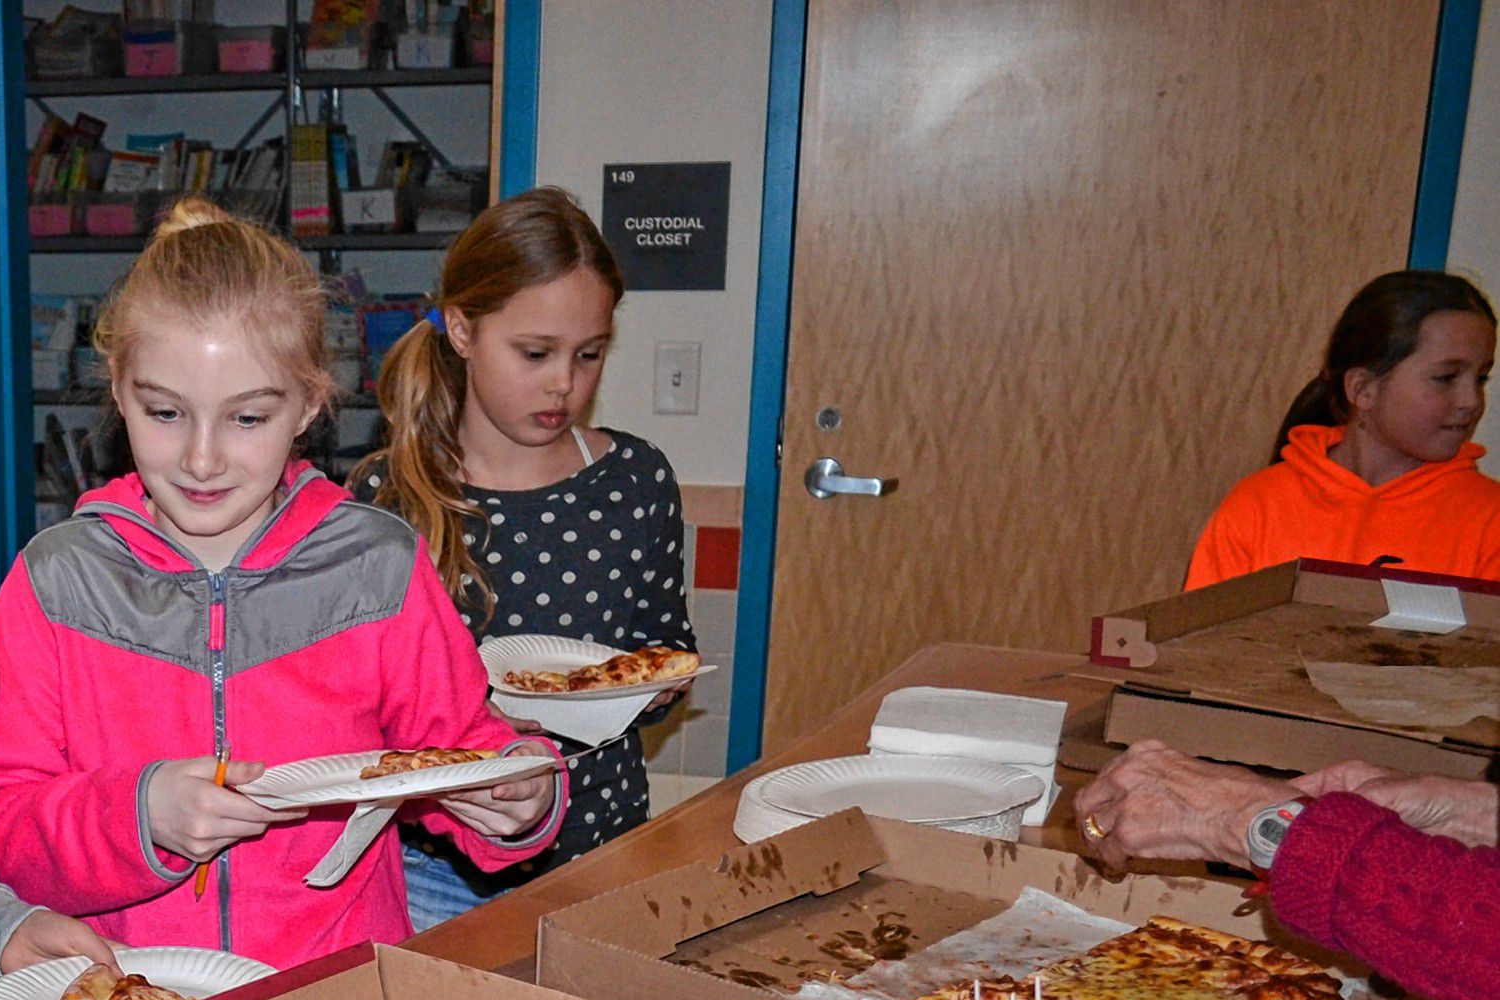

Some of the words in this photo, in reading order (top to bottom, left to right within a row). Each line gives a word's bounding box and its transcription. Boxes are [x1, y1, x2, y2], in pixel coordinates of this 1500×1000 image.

[611, 170, 636, 184] 149
[360, 197, 376, 221] K
[624, 216, 705, 231] CUSTODIAL
[636, 232, 693, 247] CLOSET
